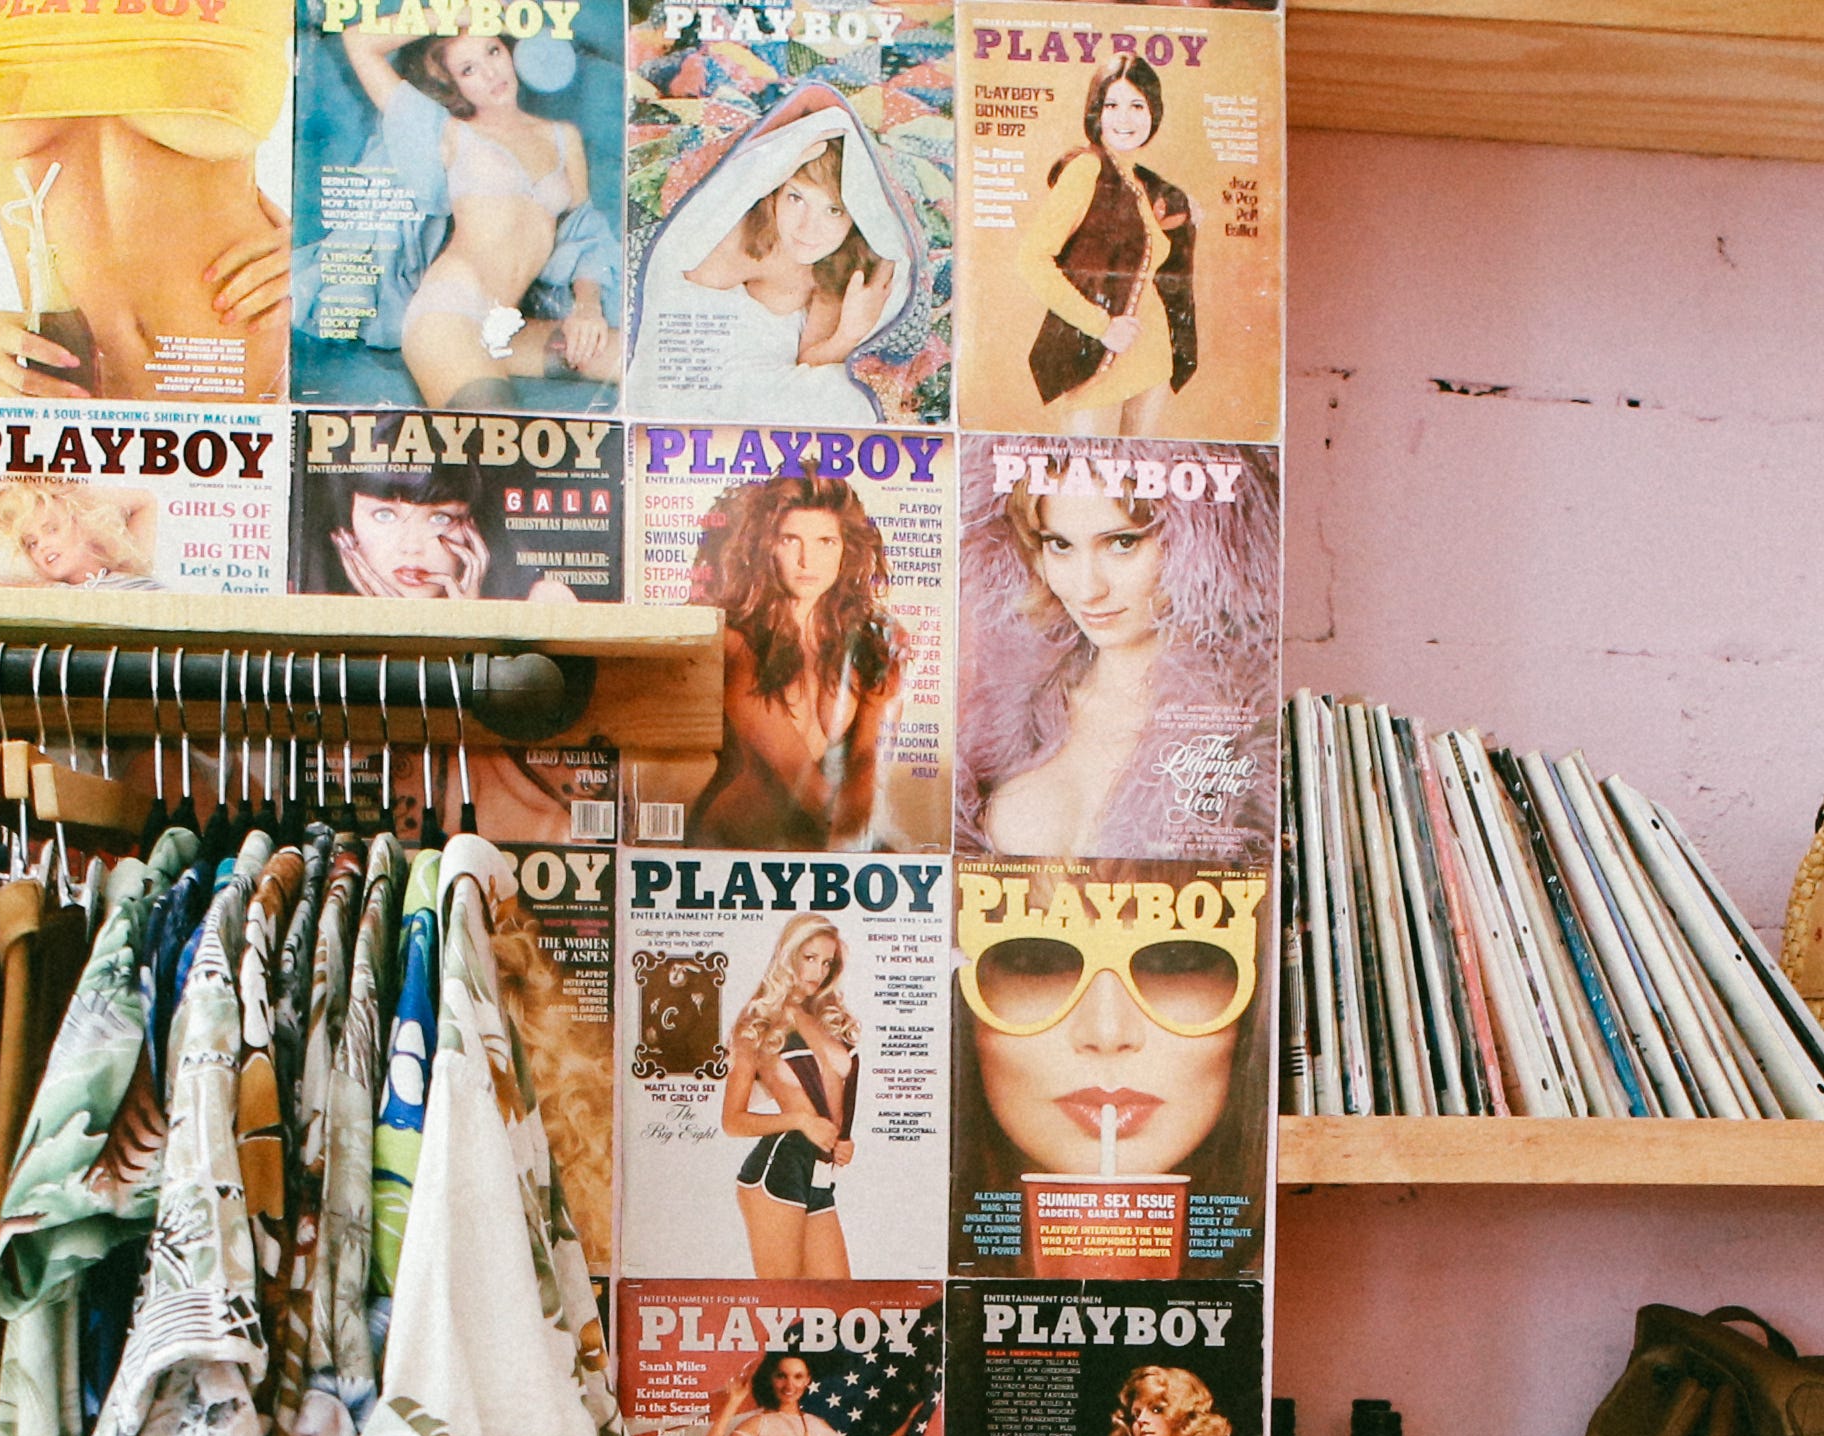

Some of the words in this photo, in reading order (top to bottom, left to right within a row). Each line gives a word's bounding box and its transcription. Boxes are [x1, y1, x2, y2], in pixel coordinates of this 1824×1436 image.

[321, 0, 580, 40] PLAYBOY
[663, 5, 903, 46] PLAYBOY
[974, 29, 1208, 67] PLAYBOY
[308, 415, 610, 468] PLAYBOY
[646, 428, 943, 482] PLAYBOY
[993, 455, 1242, 502] PLAYBOY
[168, 501, 235, 517] GIRLS
[243, 503, 271, 518] OF
[645, 496, 694, 509] SPORTS
[899, 504, 942, 515] PLAYBOY
[230, 524, 271, 539] THE
[645, 532, 707, 545] SWIMSUIT
[183, 543, 224, 559] BIG
[228, 544, 271, 560] TEN
[645, 550, 687, 563] MODEL
[180, 563, 220, 577] Let's
[227, 564, 252, 577] Do
[257, 565, 269, 578] It
[892, 561, 941, 572] THERAPIST
[917, 576, 941, 587] PECK
[1189, 734, 1238, 760] The
[1167, 788, 1226, 823] Year
[958, 863, 1041, 873] ENTERTAINMENT
[1044, 865, 1065, 873] FOR
[1068, 865, 1089, 874] MEN
[631, 860, 942, 912] PLAYBOY
[958, 873, 1266, 930] PLAYBOY
[631, 913, 713, 921] ENTERTAINMENT
[717, 913, 738, 921] FOR
[741, 913, 763, 921] MEN
[537, 937, 560, 948] THE
[564, 938, 609, 949] WOMEN
[553, 951, 567, 961] OF
[571, 951, 609, 962] ASPEN
[665, 1104, 696, 1121] The
[1037, 1193, 1097, 1207] SUMMER
[1104, 1193, 1130, 1207] SEX
[1137, 1194, 1175, 1208] ISSUE
[1038, 1210, 1082, 1219] GADGETS,
[1088, 1209, 1119, 1218] GAMES
[1124, 1210, 1143, 1218] AND
[1148, 1210, 1174, 1219] GIRLS
[984, 1295, 1057, 1303] ENTERTAINMENT
[1061, 1296, 1078, 1304] FOR
[1081, 1296, 1102, 1304] MEN
[638, 1306, 920, 1352] PLAYBOY
[983, 1305, 1232, 1347] PLAYBOY
[639, 1361, 673, 1372] Sarah
[676, 1361, 706, 1372] Miles
[648, 1375, 668, 1384] and
[674, 1374, 697, 1385] Kris
